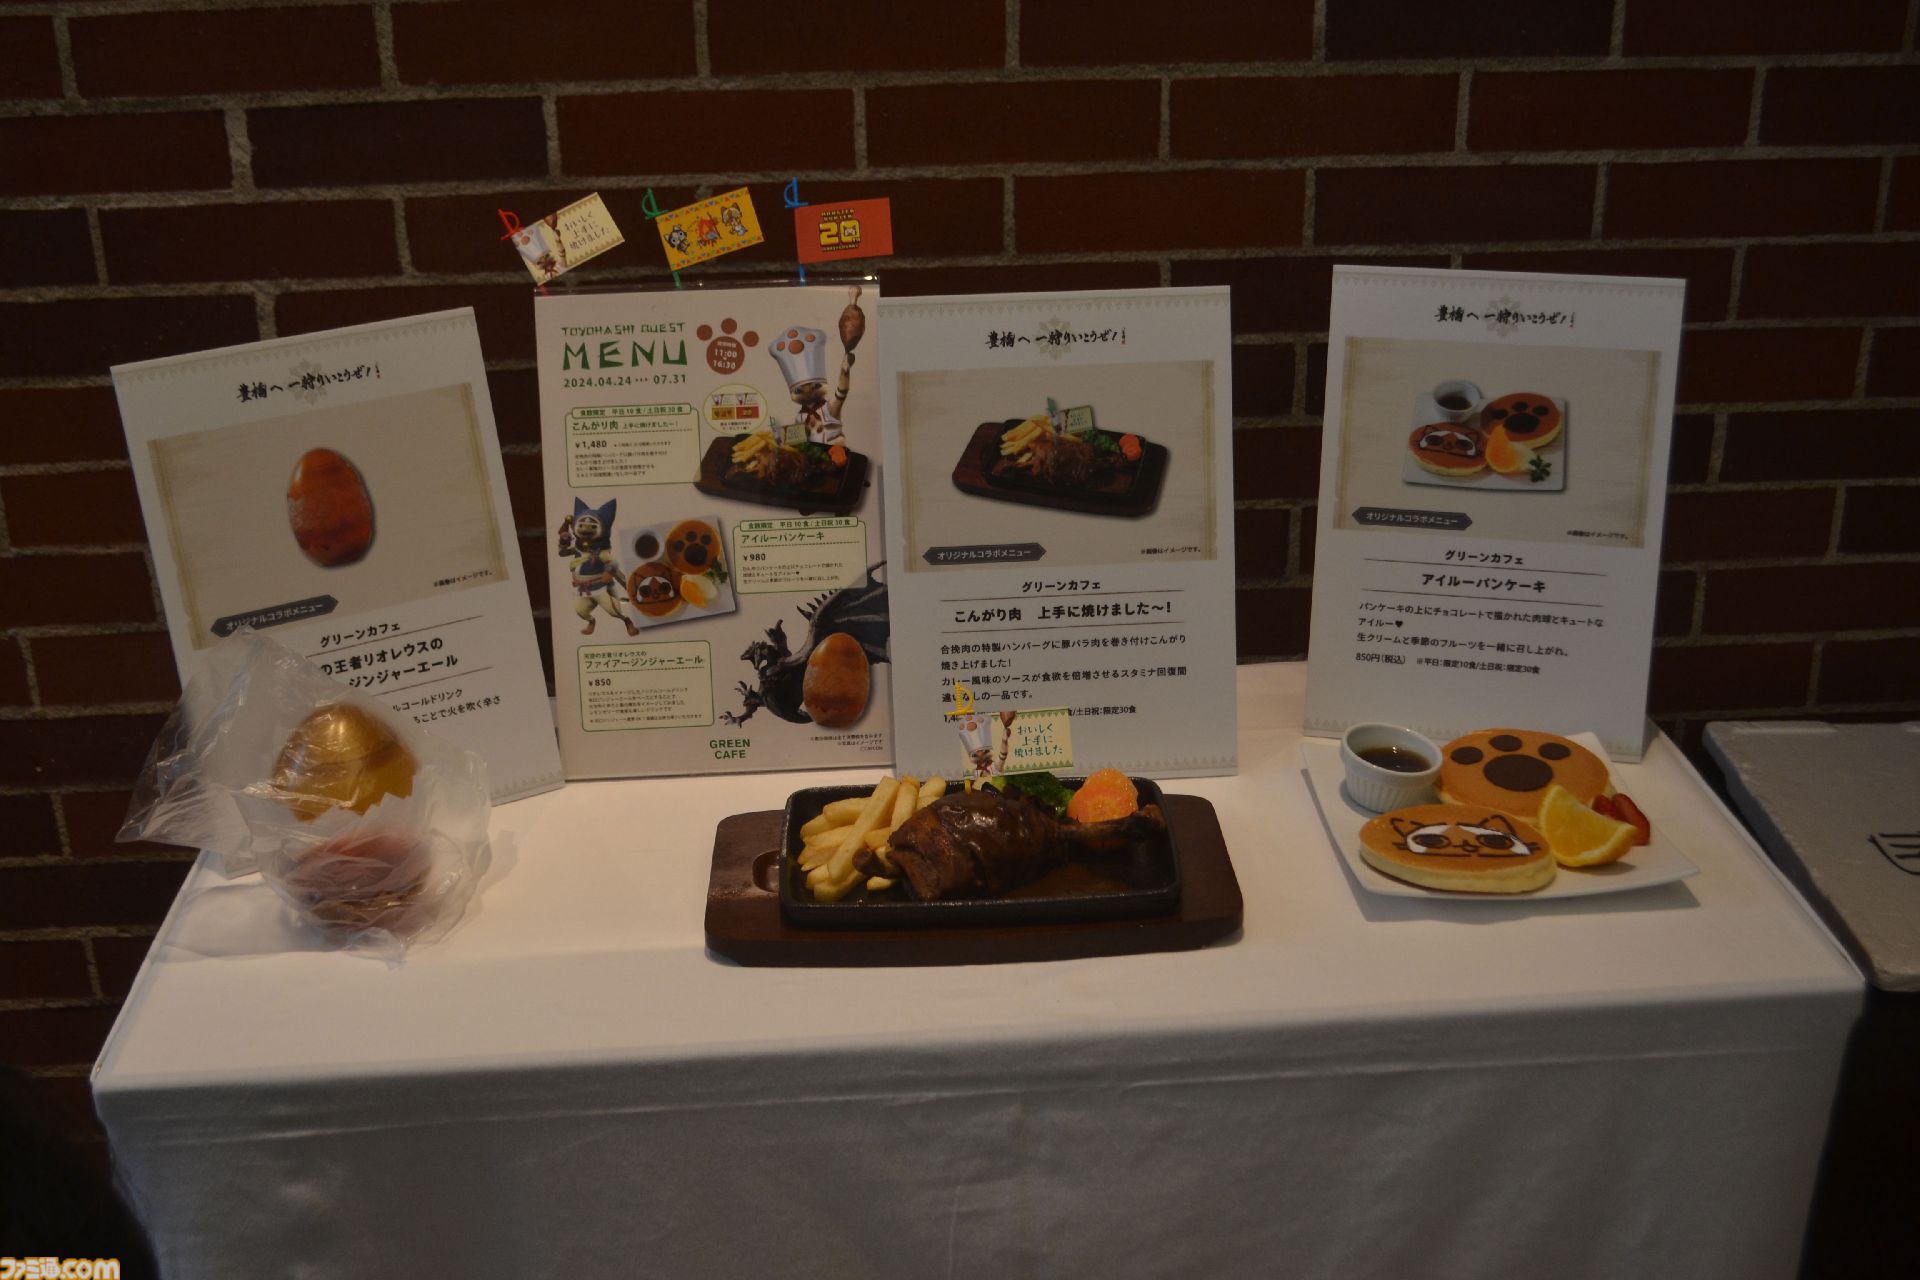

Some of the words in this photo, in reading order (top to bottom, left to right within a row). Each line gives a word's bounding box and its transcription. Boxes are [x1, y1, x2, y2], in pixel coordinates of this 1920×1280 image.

[819, 219, 860, 247] 20
[561, 324, 635, 337] TOYOHASHI
[641, 322, 686, 334] QUEST
[562, 339, 688, 371] MENU
[715, 349, 738, 358] 11:00
[713, 360, 737, 370] 16:30
[564, 376, 632, 388] 2024.04.24
[653, 374, 687, 385] 07.31
[572, 420, 619, 431] こんがり肉
[1366, 512, 1459, 526] オリジナルコラボメニュー
[741, 532, 825, 544] アイルーパンケーキ
[743, 553, 766, 561] ¥980
[937, 548, 1032, 561] オリジナルコラボメニュー
[1445, 550, 1524, 565] グリーンカフェ
[1021, 580, 1101, 593] グリーンカフェ
[1421, 573, 1546, 593] アイルーパンケーキ
[954, 608, 1022, 623] こんがり肉
[1359, 602, 1604, 628] パンケーキの上にチョコレートで描かれた肉球とキュートな
[320, 622, 401, 648] グリーンカフェ
[940, 634, 1187, 655] 合挽肉の特製ハンバーグに豚バラ肉を巻き付けこんがり
[584, 655, 703, 670] ファイアージンジャーエール
[940, 658, 1012, 671] 焼き上げました!
[349, 655, 458, 687] ジンジャーエール
[588, 678, 612, 687] ¥850
[1017, 723, 1053, 735] おいしく
[709, 739, 750, 749] GREEN
[1021, 736, 1054, 746] 上手に
[714, 750, 746, 760] CAFE
[1014, 745, 1063, 758] 焼けました
